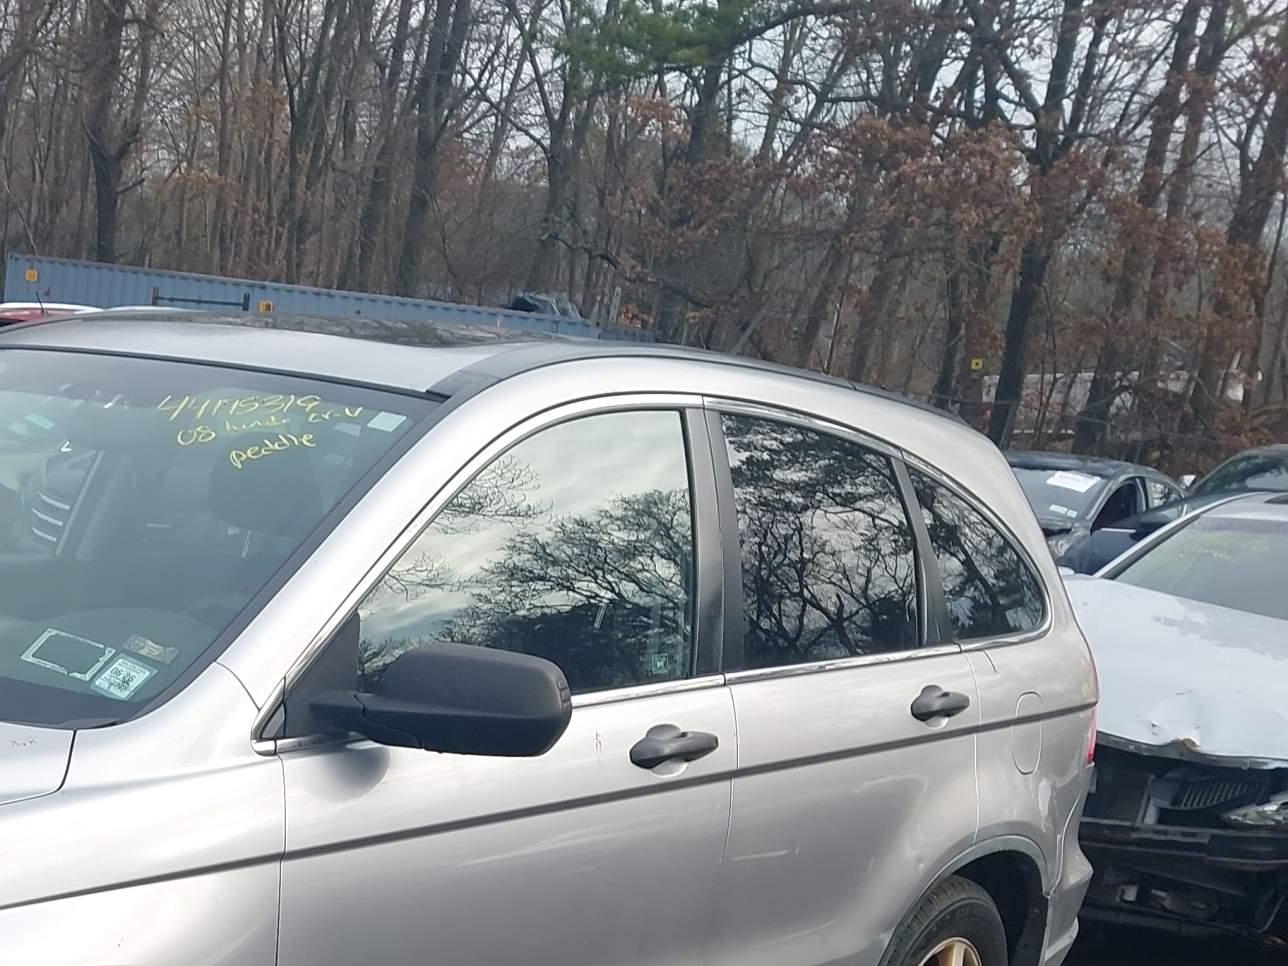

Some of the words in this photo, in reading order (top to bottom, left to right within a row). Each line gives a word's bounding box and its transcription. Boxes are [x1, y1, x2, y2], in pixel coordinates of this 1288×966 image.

[157, 394, 322, 421] 44175319
[177, 425, 216, 446] 08
[229, 432, 317, 469] peddle
